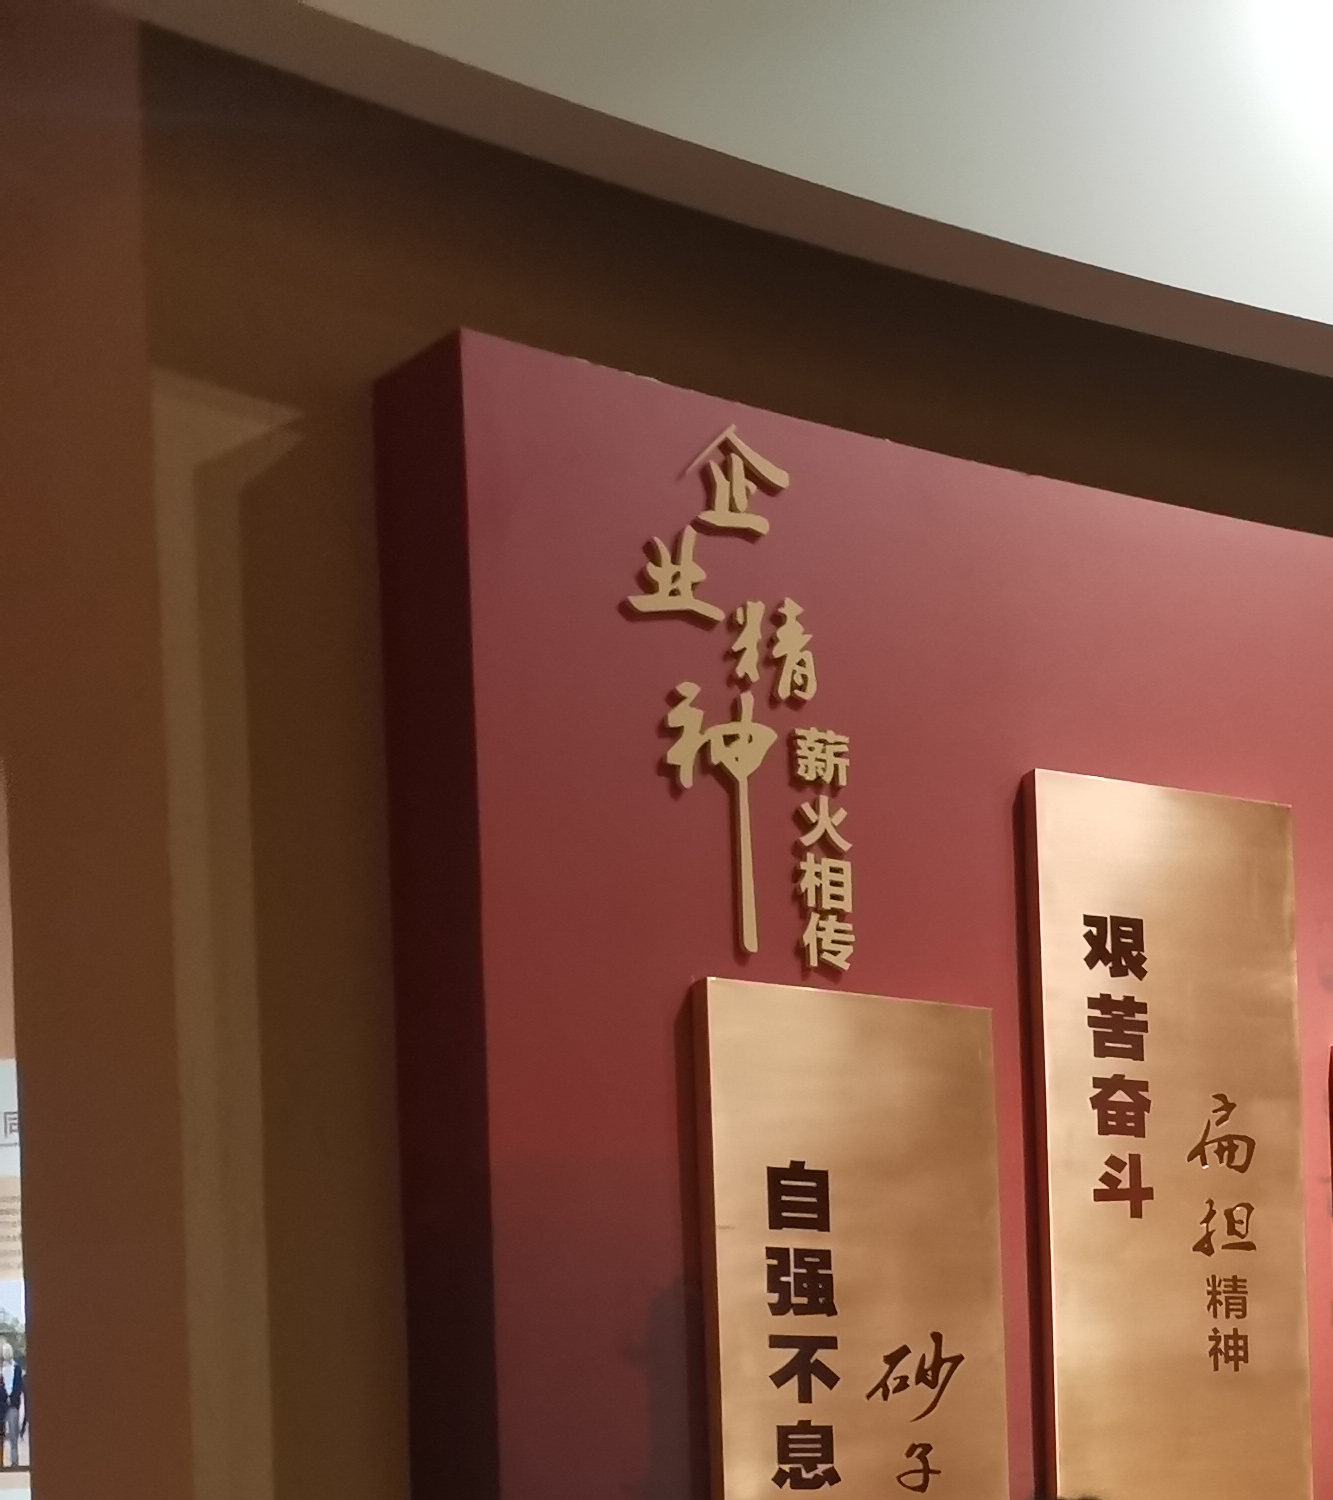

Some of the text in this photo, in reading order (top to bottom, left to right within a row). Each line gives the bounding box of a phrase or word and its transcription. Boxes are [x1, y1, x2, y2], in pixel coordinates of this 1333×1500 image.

[624, 423, 818, 953] 企业精神
[793, 726, 856, 971] 薪火相传
[1083, 914, 1154, 1219] 艰苦奋斗
[766, 1160, 842, 1491] 自强不息
[1187, 1093, 1256, 1372] 扁担精神
